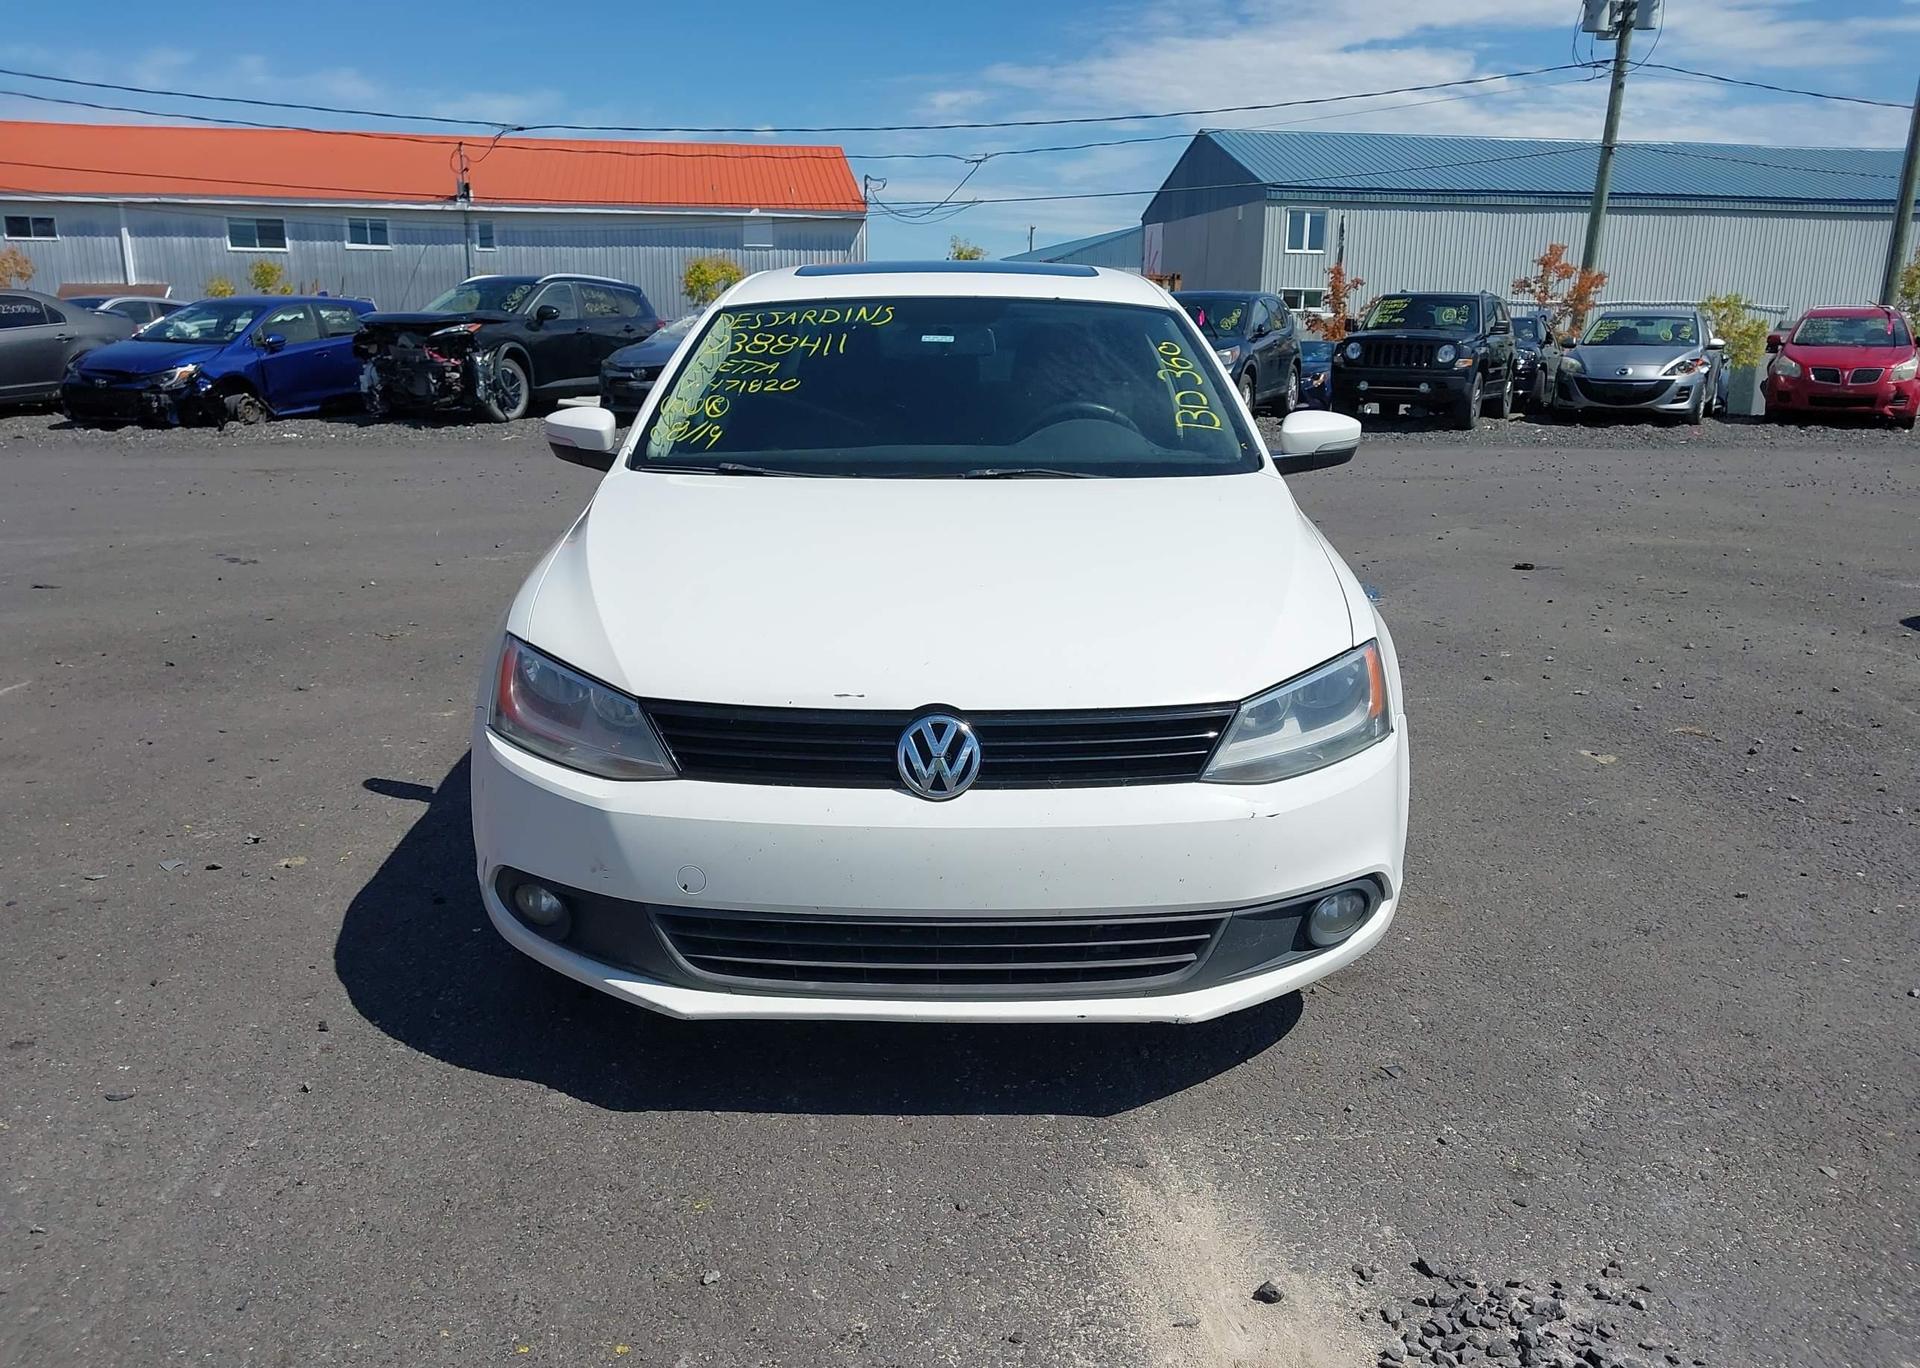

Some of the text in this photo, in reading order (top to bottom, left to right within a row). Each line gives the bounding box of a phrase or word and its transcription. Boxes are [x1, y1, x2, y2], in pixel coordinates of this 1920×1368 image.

[719, 304, 896, 331] DESJARDINS
[706, 332, 846, 357] 2388411
[1157, 341, 1223, 431] BD 360
